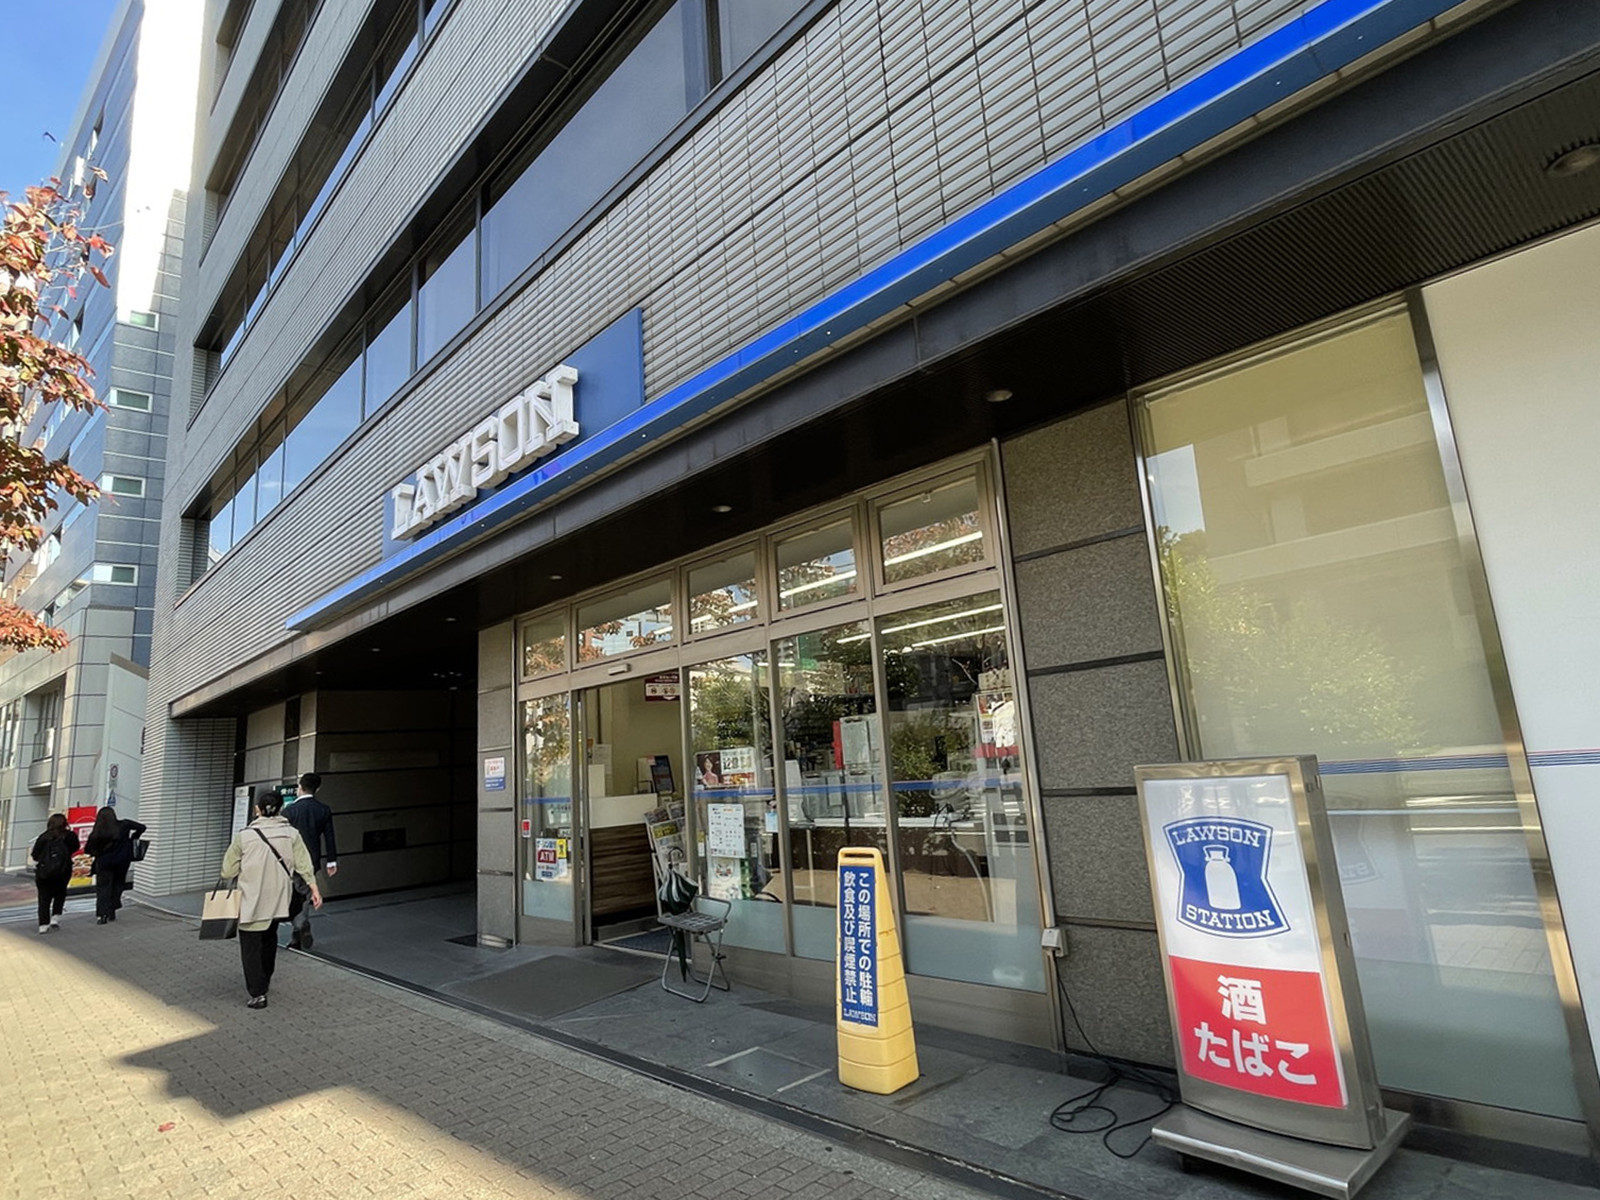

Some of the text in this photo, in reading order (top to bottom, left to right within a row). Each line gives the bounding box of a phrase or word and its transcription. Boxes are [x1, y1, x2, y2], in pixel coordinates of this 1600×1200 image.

[391, 364, 579, 541] LAWSON
[540, 851, 555, 862] ATM
[1174, 826, 1261, 848] LAWSON
[844, 870, 857, 1004] 飲食及び喫煙禁止
[858, 872, 873, 1007] この場所での駐輪
[1185, 905, 1274, 930] STATION
[1217, 975, 1266, 1024] 酒
[1194, 1022, 1317, 1085] たばこ
